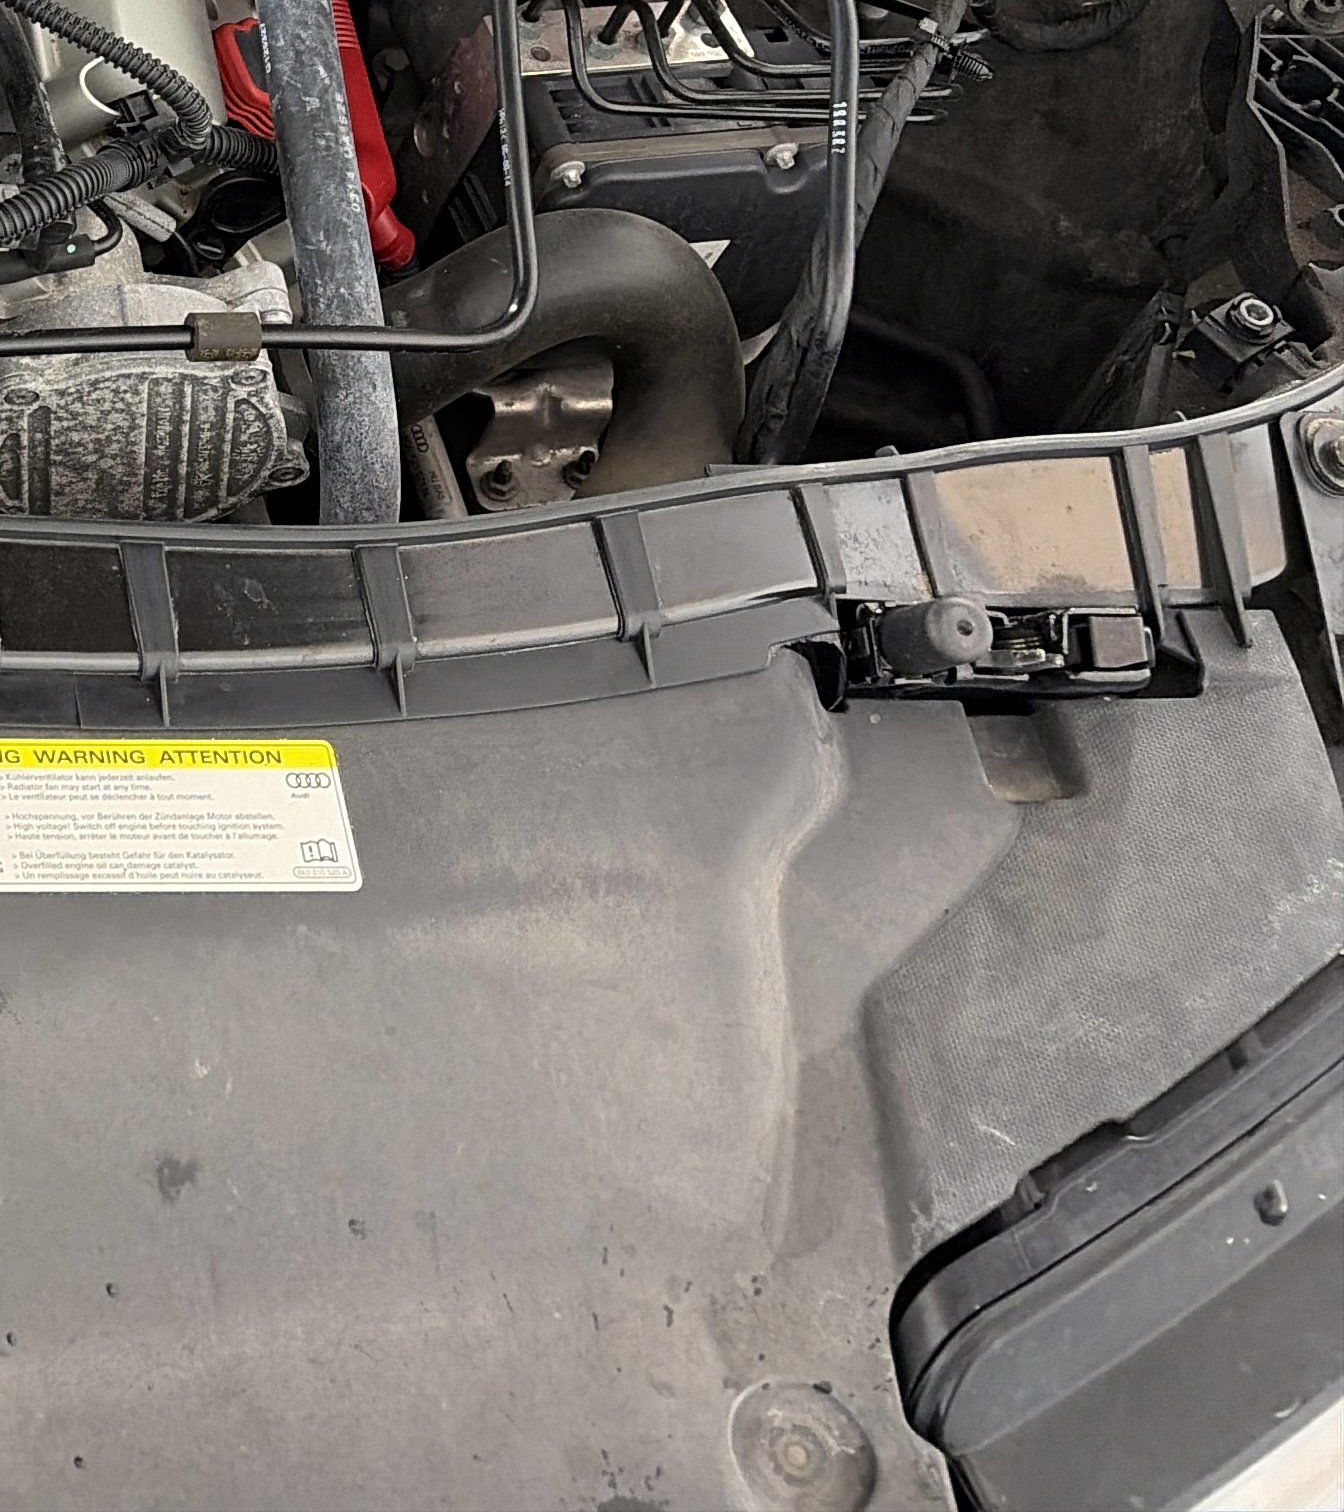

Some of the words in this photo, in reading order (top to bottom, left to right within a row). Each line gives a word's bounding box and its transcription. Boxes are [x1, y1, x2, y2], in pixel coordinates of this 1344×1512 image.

[33, 750, 146, 764] WARNING
[160, 750, 282, 764] ATTENTION
[7, 783, 43, 791] Radiator
[113, 784, 128, 792] any
[14, 823, 34, 831] High
[179, 823, 216, 832] touching
[218, 823, 251, 831] ignition
[178, 832, 188, 840] de
[122, 851, 151, 859] Gefahr
[65, 862, 94, 870] engine
[22, 871, 35, 879] Un
[37, 872, 89, 880] remplissage
